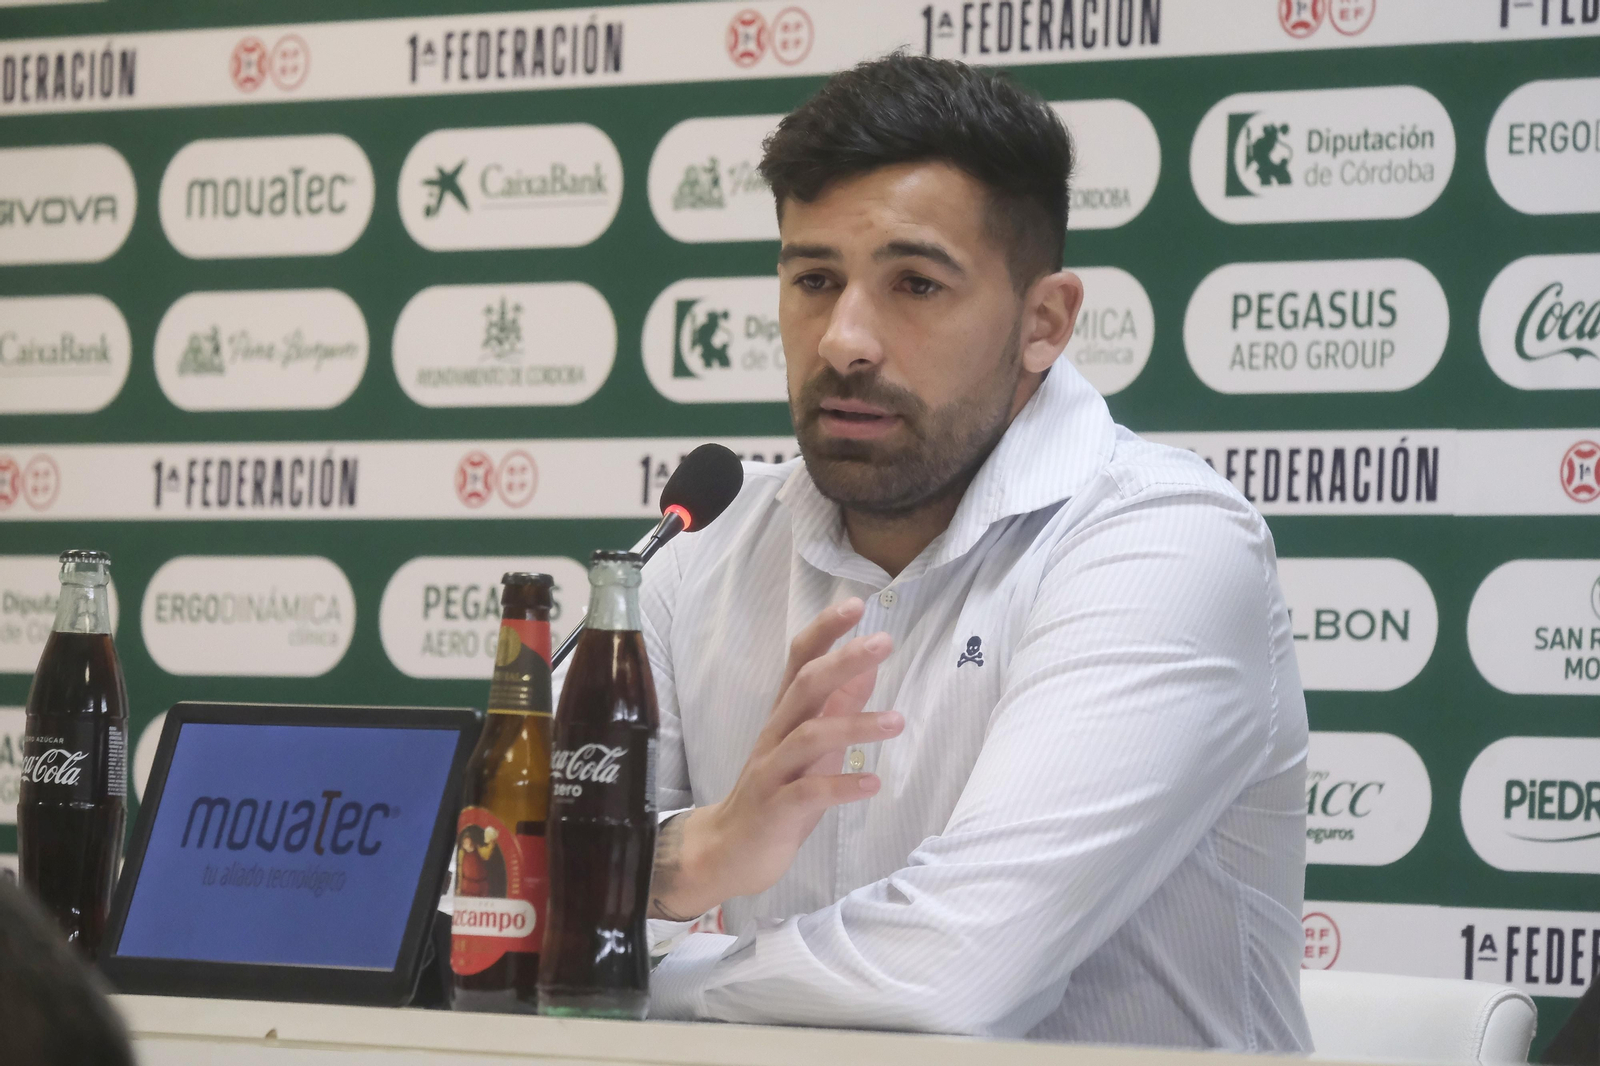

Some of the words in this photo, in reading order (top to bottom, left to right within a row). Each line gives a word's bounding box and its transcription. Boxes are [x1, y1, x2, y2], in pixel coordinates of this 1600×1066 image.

[444, 14, 624, 82] FEDERACIÓN
[1307, 124, 1435, 158] Diputación
[479, 160, 608, 199] CaixaBank
[1304, 164, 1332, 187] de
[1340, 159, 1435, 186] Córdoba
[1232, 288, 1398, 331] PEGASUS
[1229, 342, 1299, 371] AERO
[1306, 339, 1396, 370] GROUP
[186, 449, 358, 507] FEDERACIÓN
[1226, 436, 1439, 502] FEDERACIÓN
[421, 628, 482, 658] AERO
[1535, 627, 1583, 650] SAN
[36, 734, 65, 745] AZÚCAR
[554, 783, 583, 797] zero
